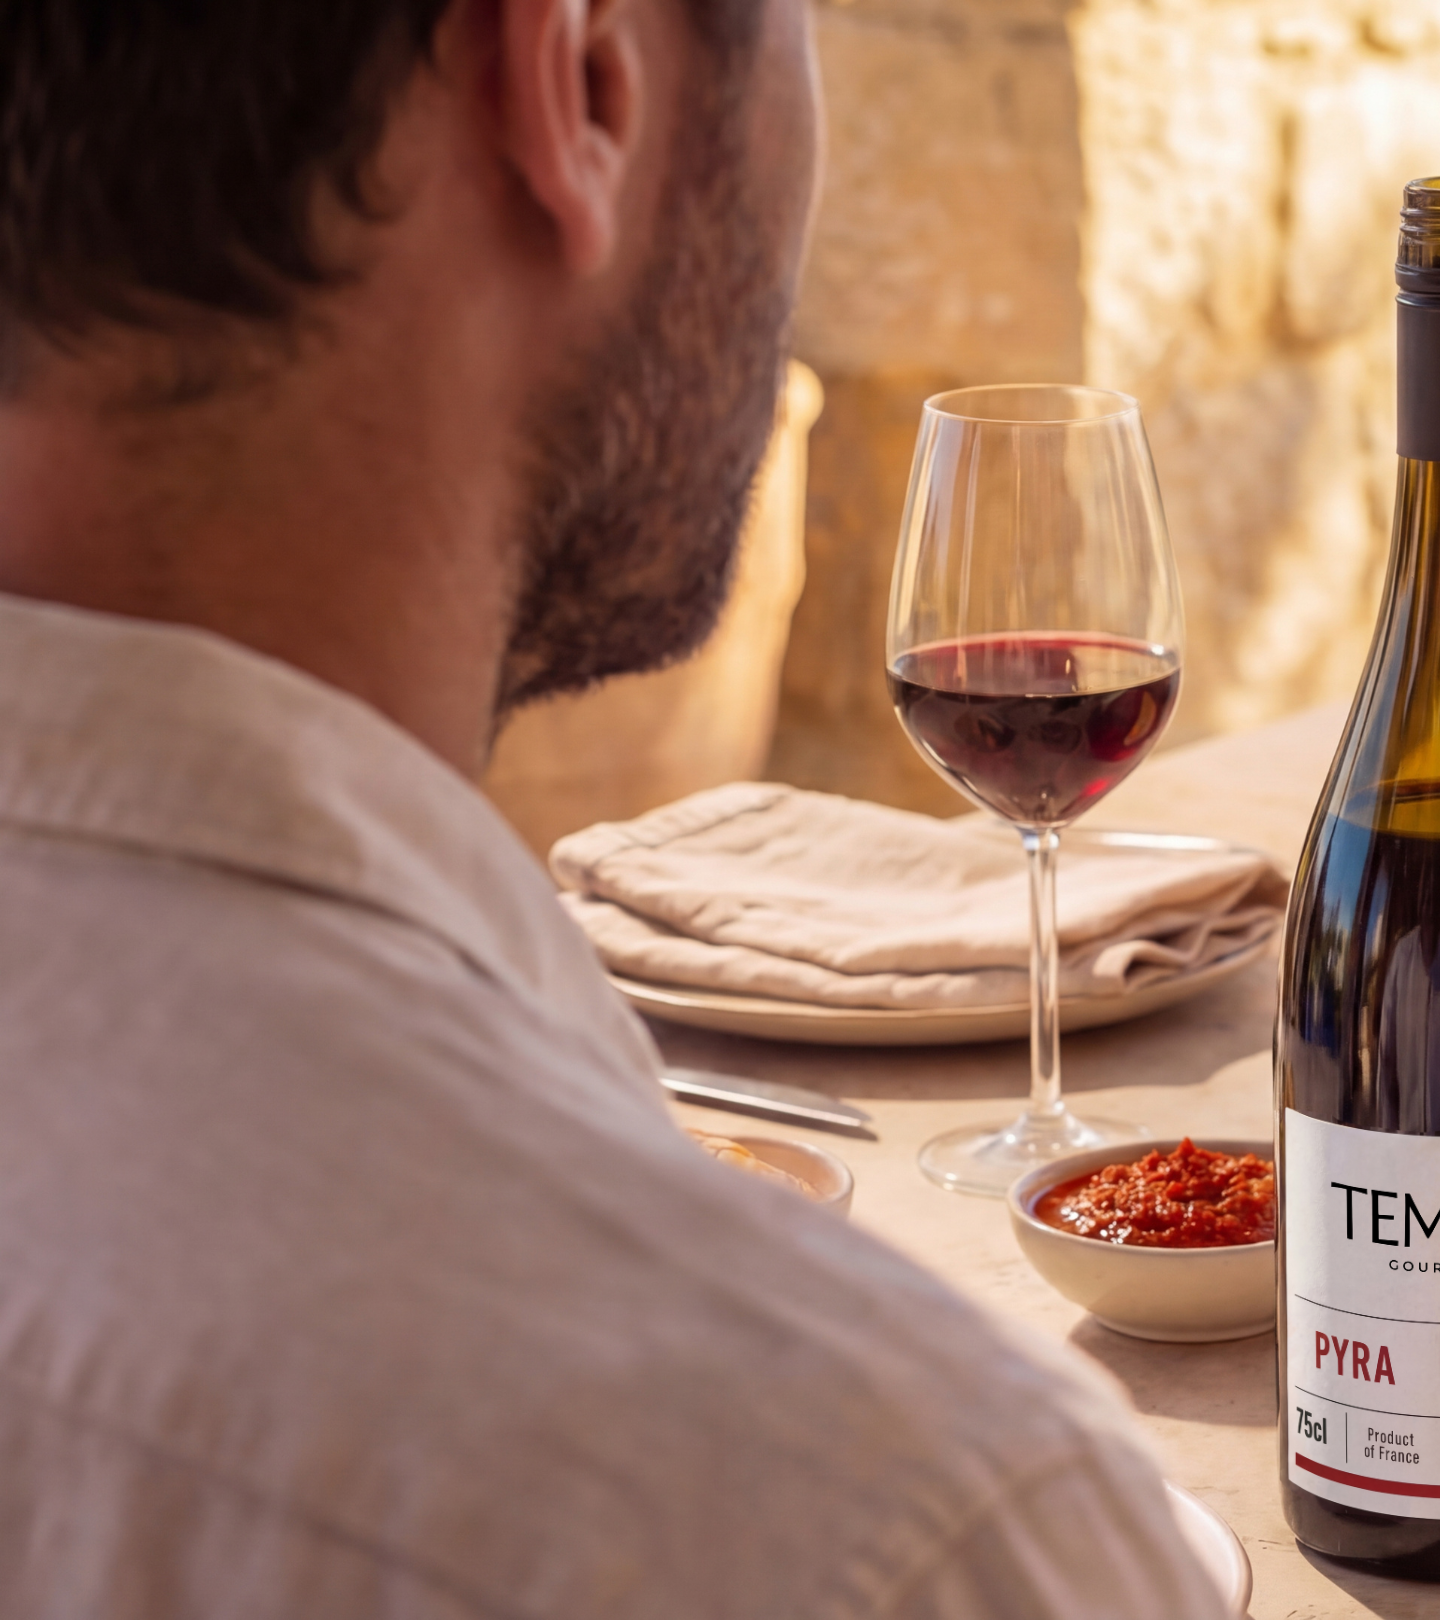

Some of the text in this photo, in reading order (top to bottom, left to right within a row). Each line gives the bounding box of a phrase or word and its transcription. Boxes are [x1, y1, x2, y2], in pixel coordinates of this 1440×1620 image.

[1315, 1330, 1396, 1385] PYRA
[1296, 1406, 1328, 1444] 75cl
[1367, 1427, 1415, 1447] Product
[1364, 1445, 1420, 1464] of France
